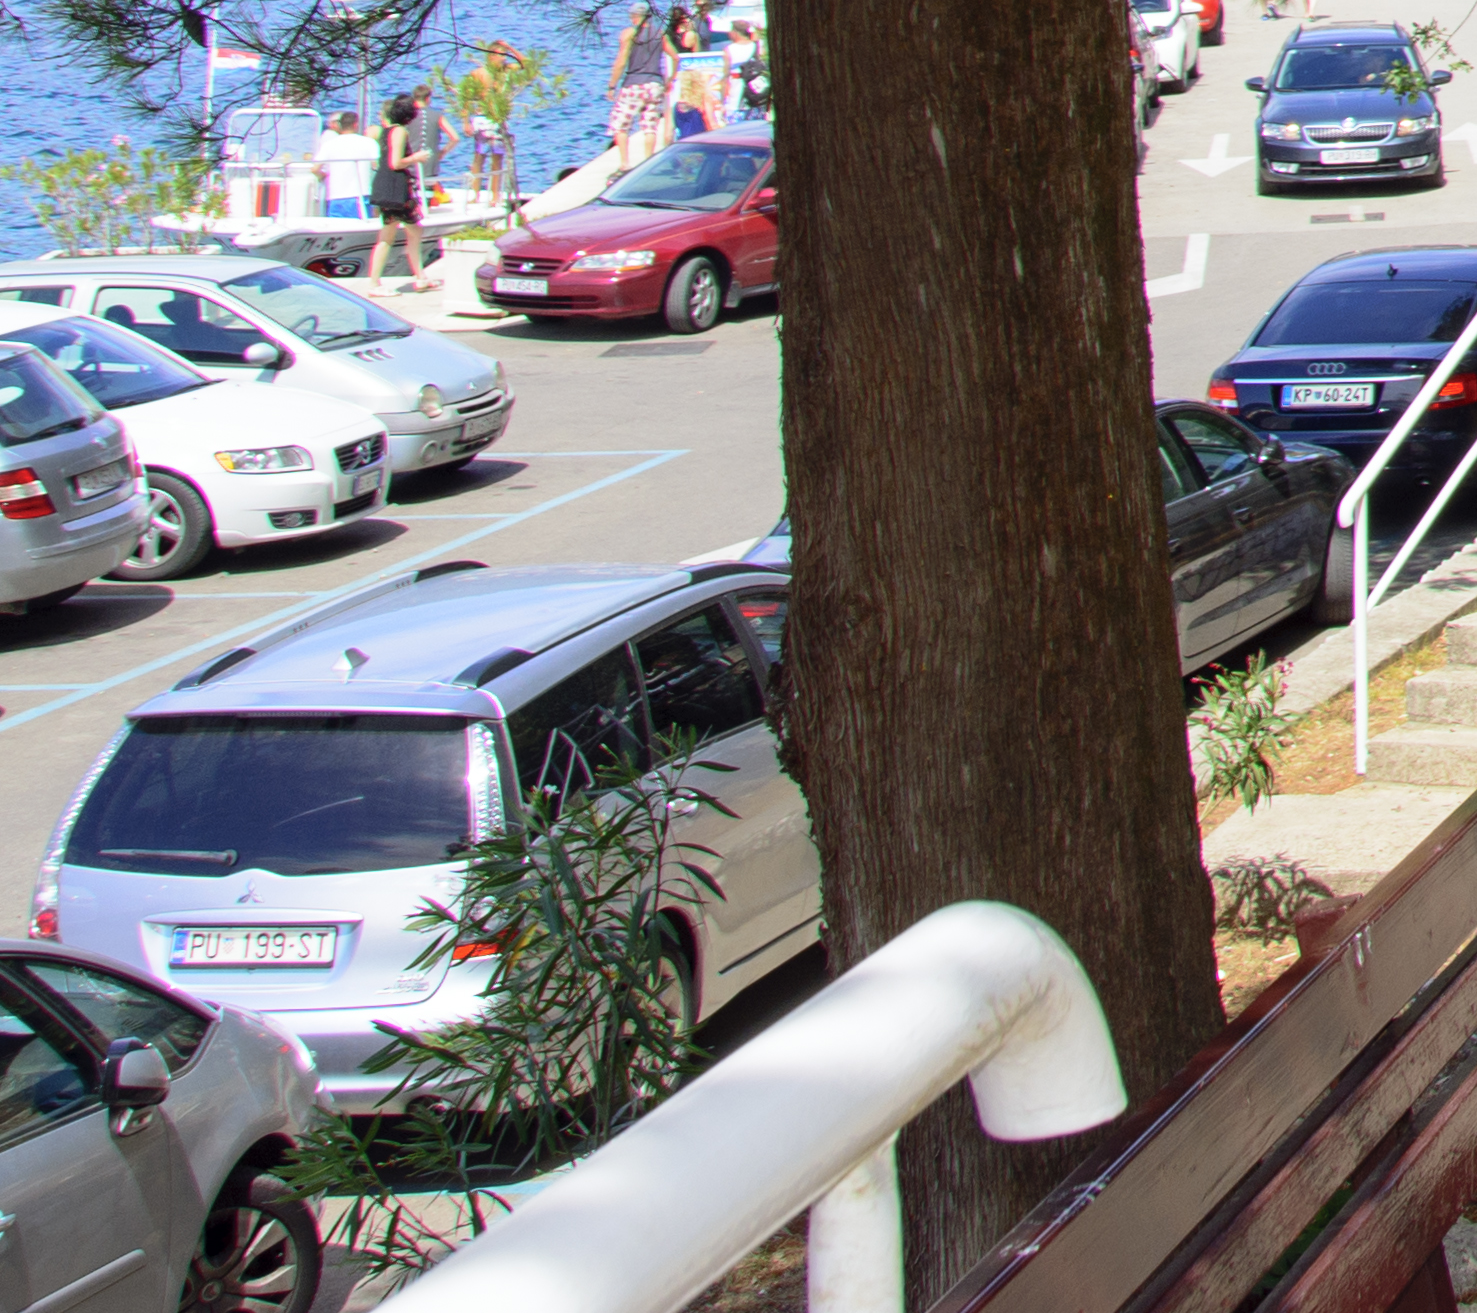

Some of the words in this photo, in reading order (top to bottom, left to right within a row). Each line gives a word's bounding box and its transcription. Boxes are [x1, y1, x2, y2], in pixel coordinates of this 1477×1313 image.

[1293, 388, 1312, 403] KP
[190, 933, 221, 959] PU
[243, 932, 330, 960] 199-ST
